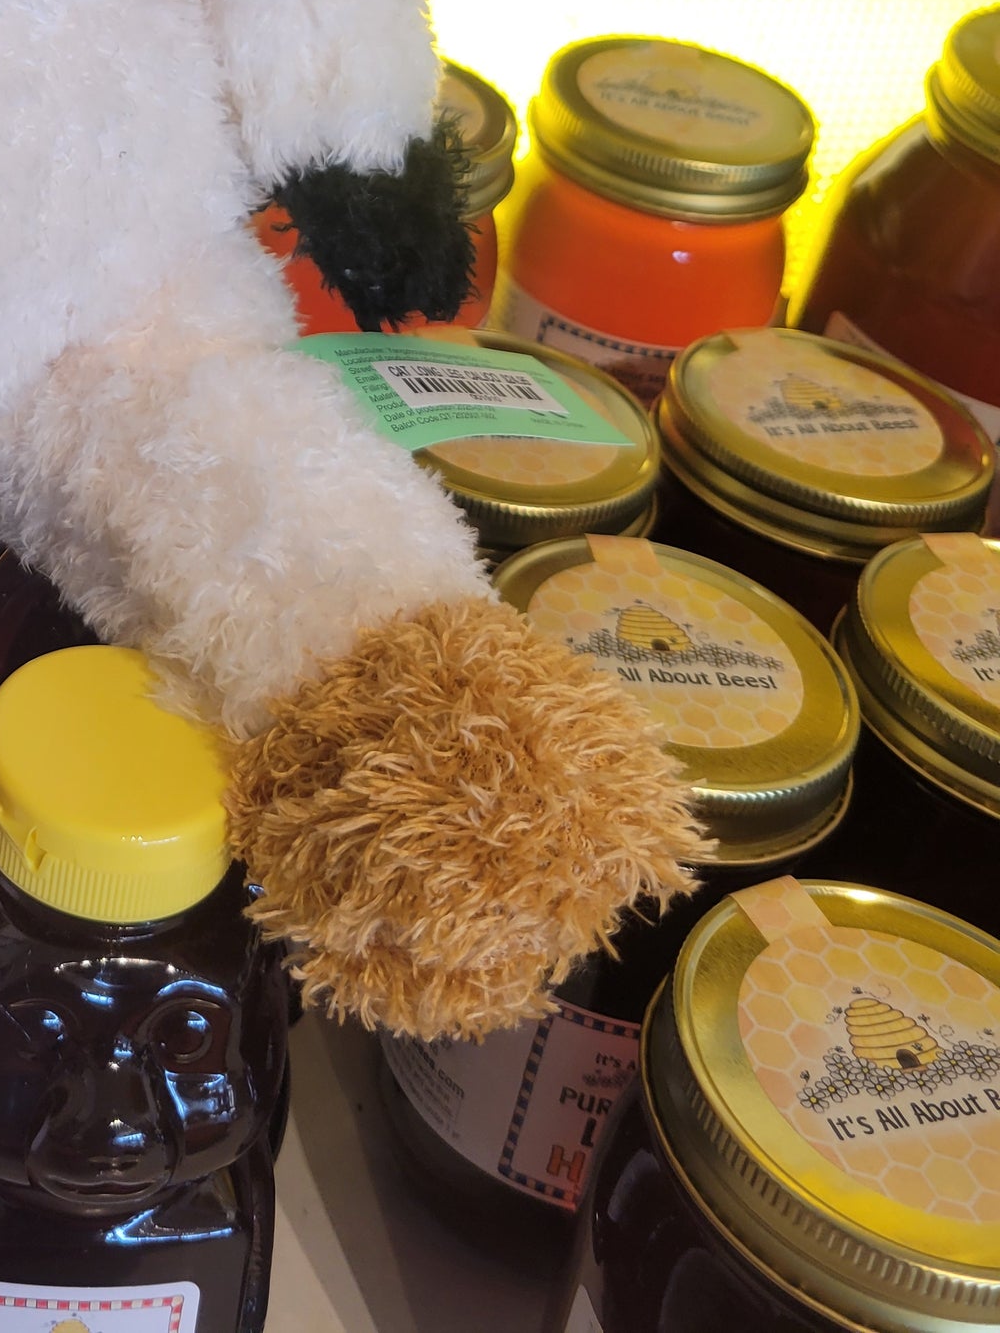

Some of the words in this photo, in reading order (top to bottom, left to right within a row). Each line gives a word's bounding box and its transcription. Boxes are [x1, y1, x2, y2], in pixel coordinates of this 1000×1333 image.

[387, 365, 412, 378] CAT
[410, 365, 444, 378] LONG
[383, 412, 406, 423] Date
[390, 420, 416, 433] Batch
[796, 424, 818, 435] All
[820, 421, 870, 434] About
[870, 419, 919, 431] Bees!
[616, 666, 643, 682] All
[649, 668, 712, 686] About
[715, 671, 778, 690] Bees!
[558, 1085, 613, 1116] PUR
[827, 1115, 875, 1142] It's
[875, 1105, 911, 1132] All
[910, 1093, 988, 1125] About
